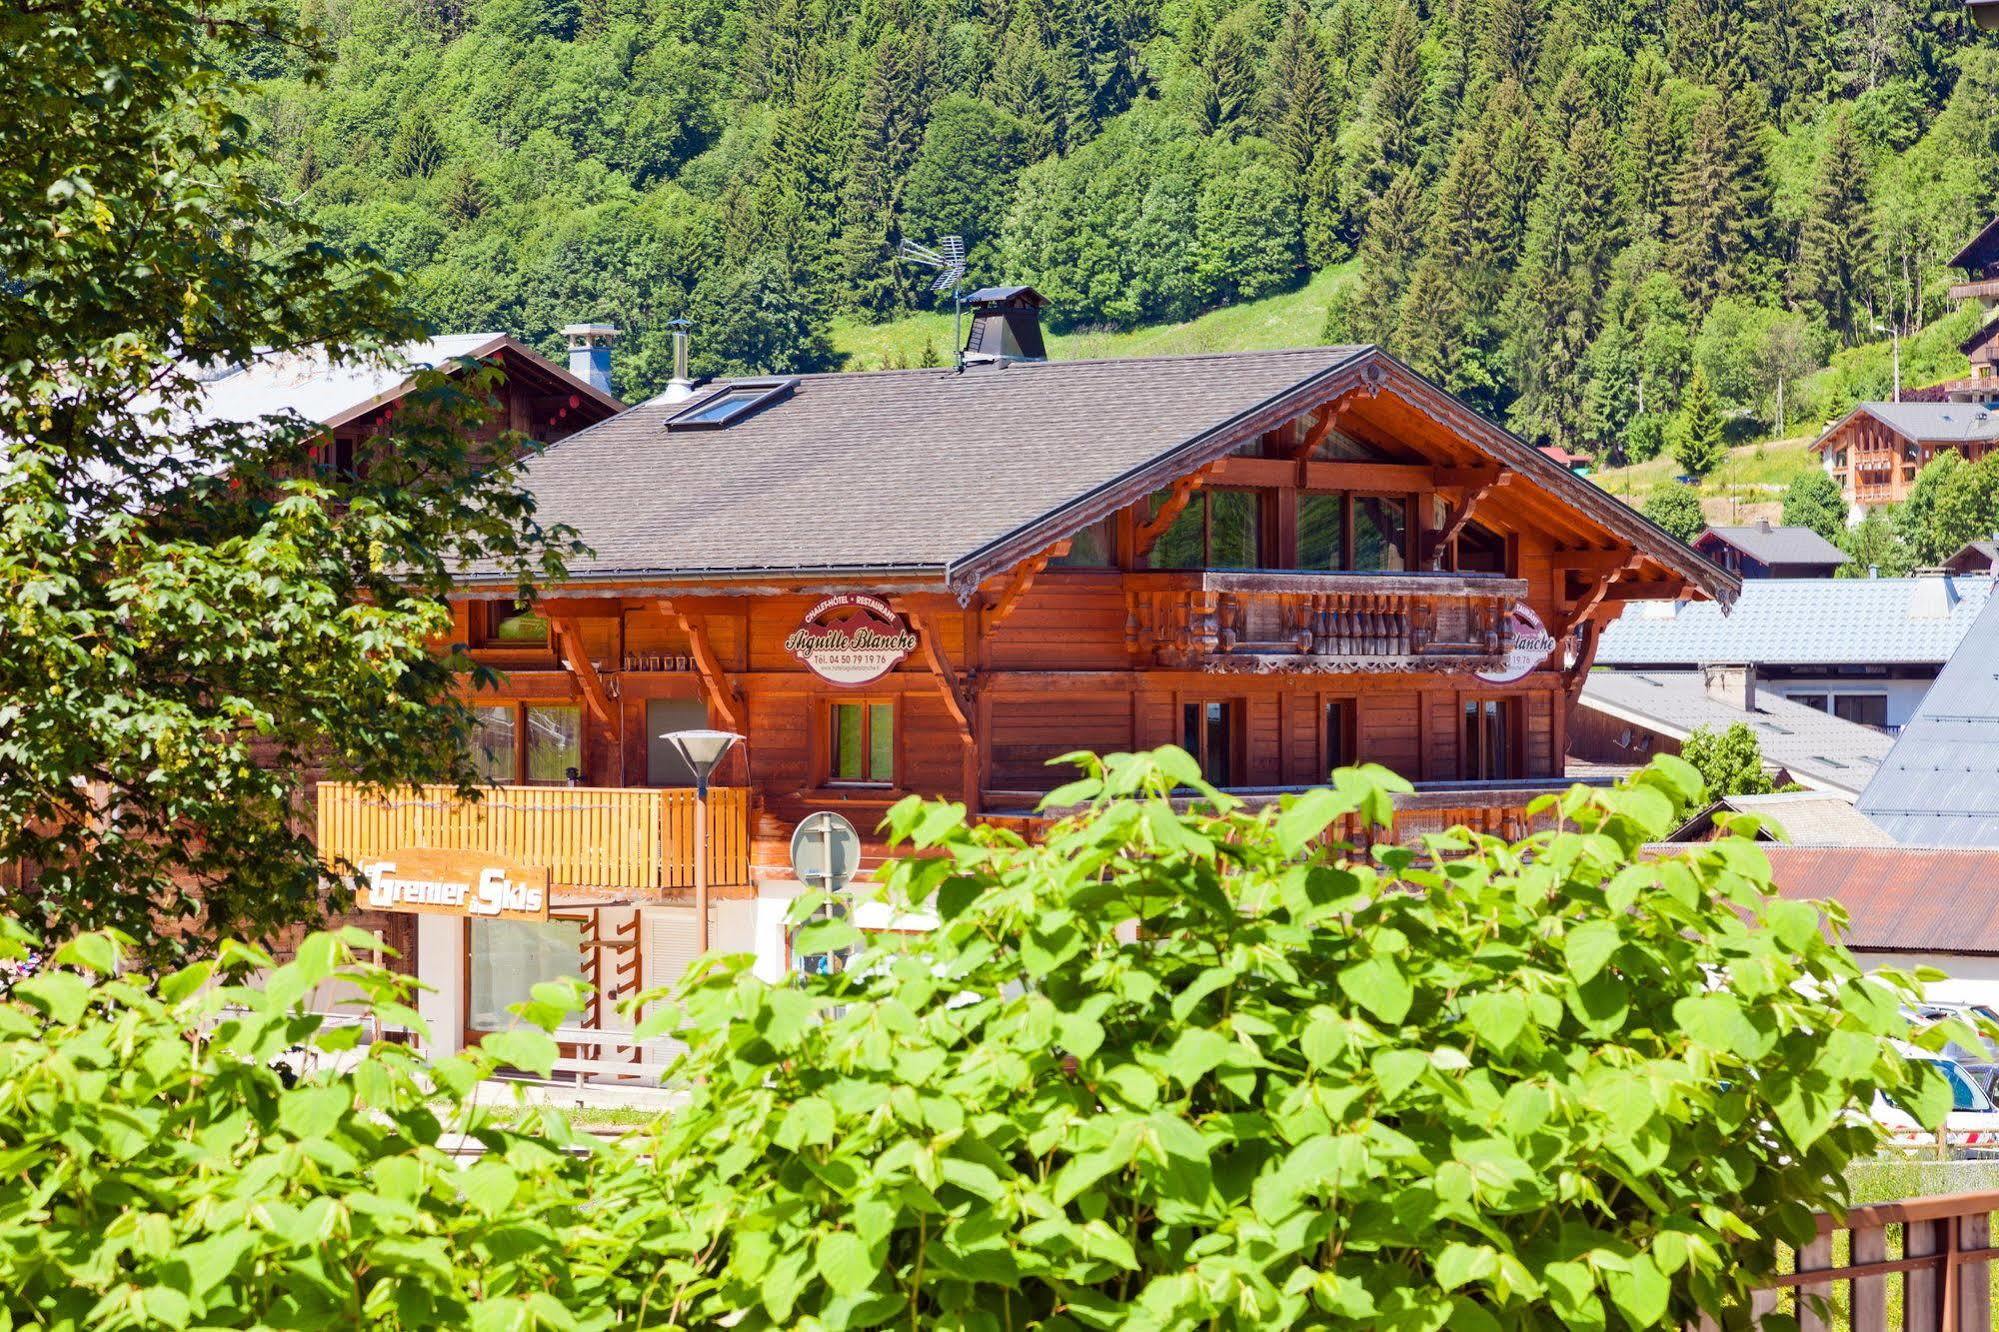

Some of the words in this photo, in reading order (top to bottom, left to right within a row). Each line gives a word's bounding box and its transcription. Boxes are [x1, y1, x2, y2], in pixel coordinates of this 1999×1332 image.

[805, 595, 849, 623] CHALET-HÔTEL
[856, 596, 896, 622] RESTAURANT
[1516, 603, 1539, 625] TAURANT
[785, 629, 849, 656] Aiguille
[851, 627, 916, 650] Blanche
[1514, 631, 1554, 650] lanche
[829, 655, 839, 664] 04
[841, 655, 850, 664] 50
[853, 655, 862, 664] 79
[865, 655, 874, 664] 19
[877, 655, 886, 664] 76
[1513, 656, 1520, 664] 19
[1522, 656, 1530, 664] 76
[369, 862, 471, 907] Grenier
[478, 867, 544, 915] Skis
